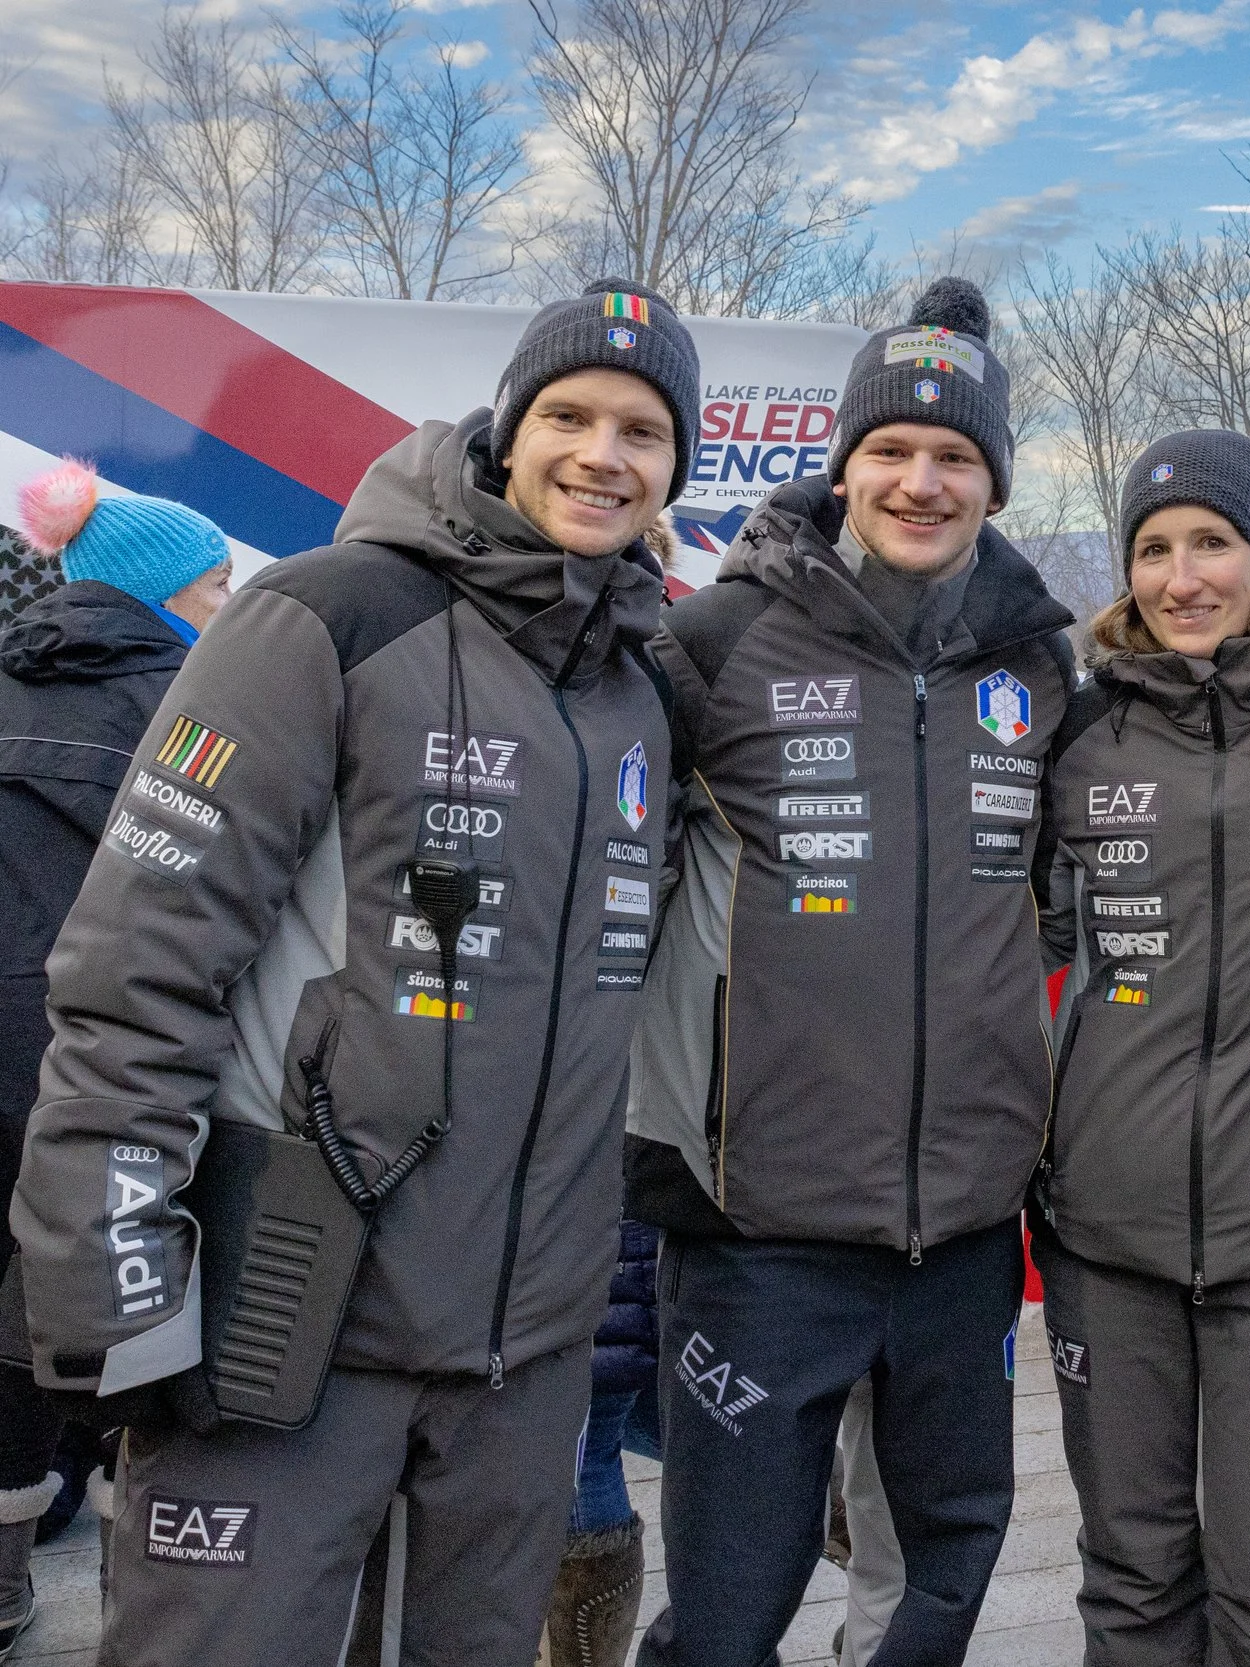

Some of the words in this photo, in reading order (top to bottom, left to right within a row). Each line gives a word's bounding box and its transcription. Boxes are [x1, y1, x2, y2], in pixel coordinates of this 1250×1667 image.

[891, 339, 972, 361] Passeiertal
[705, 385, 759, 400] LAKE
[765, 387, 837, 402] PLACID
[716, 489, 771, 497] CHEVRO
[987, 675, 1021, 694] FISI
[772, 679, 853, 711] EA7
[776, 712, 814, 722] EMPORIO
[826, 710, 857, 719] ARMANI
[425, 732, 519, 776] EA7
[788, 767, 816, 777] Audi
[970, 754, 1038, 776] FALCONERI
[479, 775, 516, 790] ARMANI
[133, 770, 223, 828] FALCONERI
[779, 795, 863, 816] PIRELLI
[986, 793, 1032, 812] CARABINIERI
[1089, 783, 1158, 815] EA7
[1089, 815, 1119, 826] EMPORIO
[1128, 813, 1157, 823] ARMANI
[110, 810, 198, 872] Dicoflor
[424, 838, 459, 851] Audi
[779, 831, 869, 860] FORST
[986, 833, 1021, 848] FINSTRAL
[607, 841, 649, 865] FALCONERI
[972, 868, 1026, 877] PIQUADRO
[1096, 868, 1118, 877] Audi
[617, 890, 648, 906] ESERCITO
[1093, 896, 1162, 916] PIRELLI
[391, 915, 501, 957] FOST
[610, 932, 647, 949] FINSTRAL
[1096, 931, 1169, 957] FORST
[109, 1171, 164, 1314] Audi
[681, 1331, 770, 1416] EA7
[150, 1502, 250, 1548] EA7
[149, 1542, 190, 1559] EMPORIO
[202, 1549, 245, 1562] ARMANI
